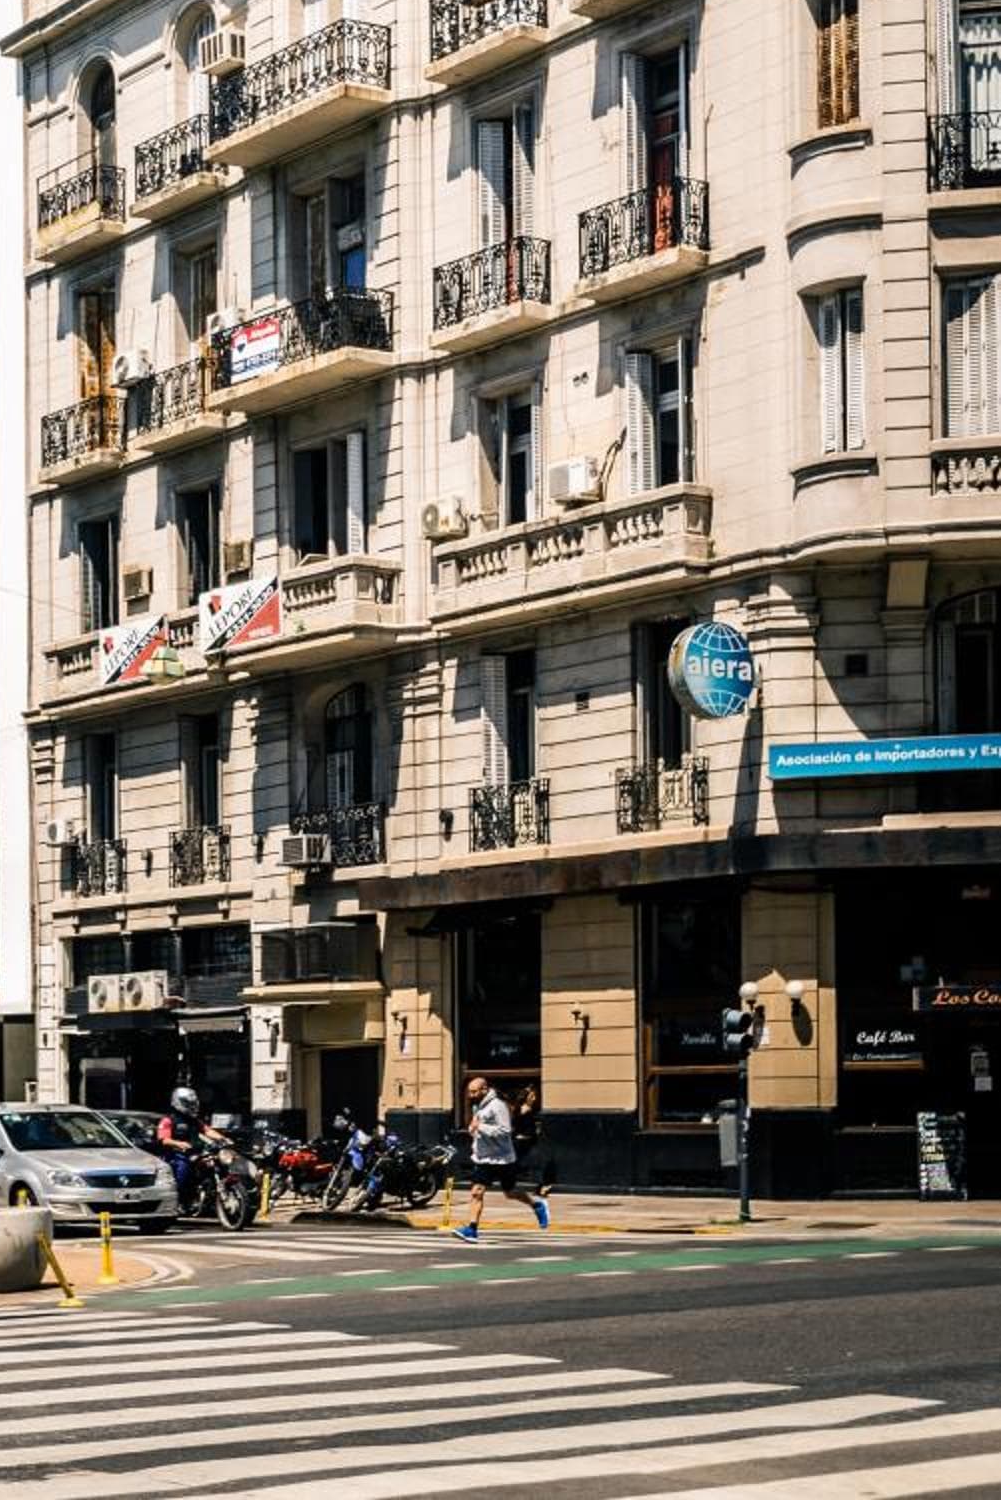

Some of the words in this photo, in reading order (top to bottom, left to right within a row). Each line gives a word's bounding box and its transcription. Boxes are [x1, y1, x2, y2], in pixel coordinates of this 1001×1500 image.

[208, 587, 254, 639] LEPORE
[687, 650, 752, 681] aiera
[776, 750, 852, 767] Asociación
[854, 749, 872, 763] de
[874, 747, 966, 763] Importadores
[968, 747, 977, 759] y
[931, 988, 970, 1005] Los
[973, 988, 1001, 1005] Co
[856, 1030, 888, 1047] Café
[888, 1030, 915, 1044] Bar
